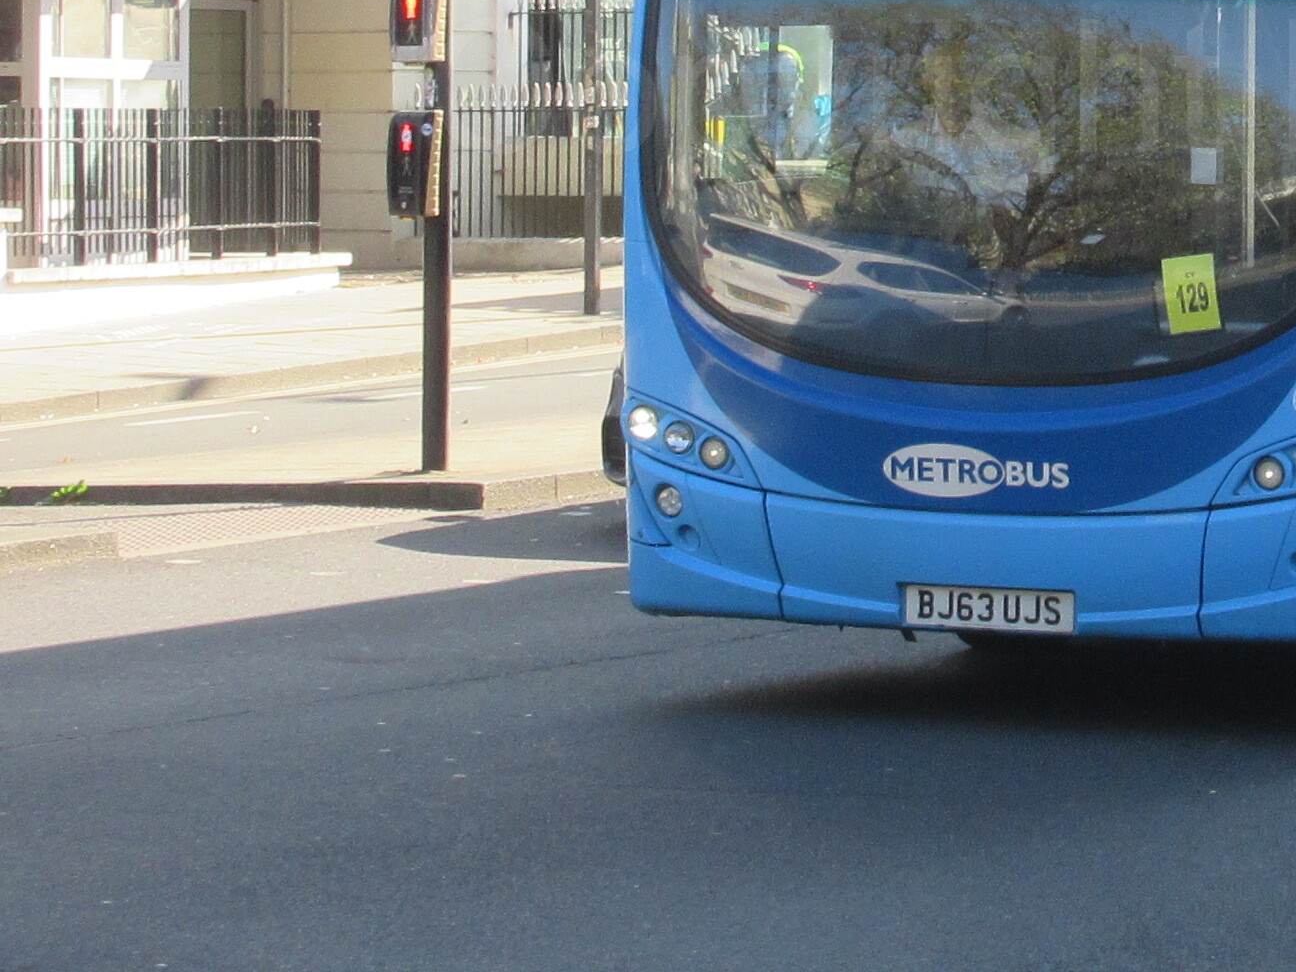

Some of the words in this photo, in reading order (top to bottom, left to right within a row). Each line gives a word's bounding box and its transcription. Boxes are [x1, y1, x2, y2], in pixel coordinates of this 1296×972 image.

[1176, 282, 1210, 314] 129
[888, 455, 1071, 490] METROBUS
[916, 589, 995, 623] BJ63
[1002, 592, 1062, 626] UJS
